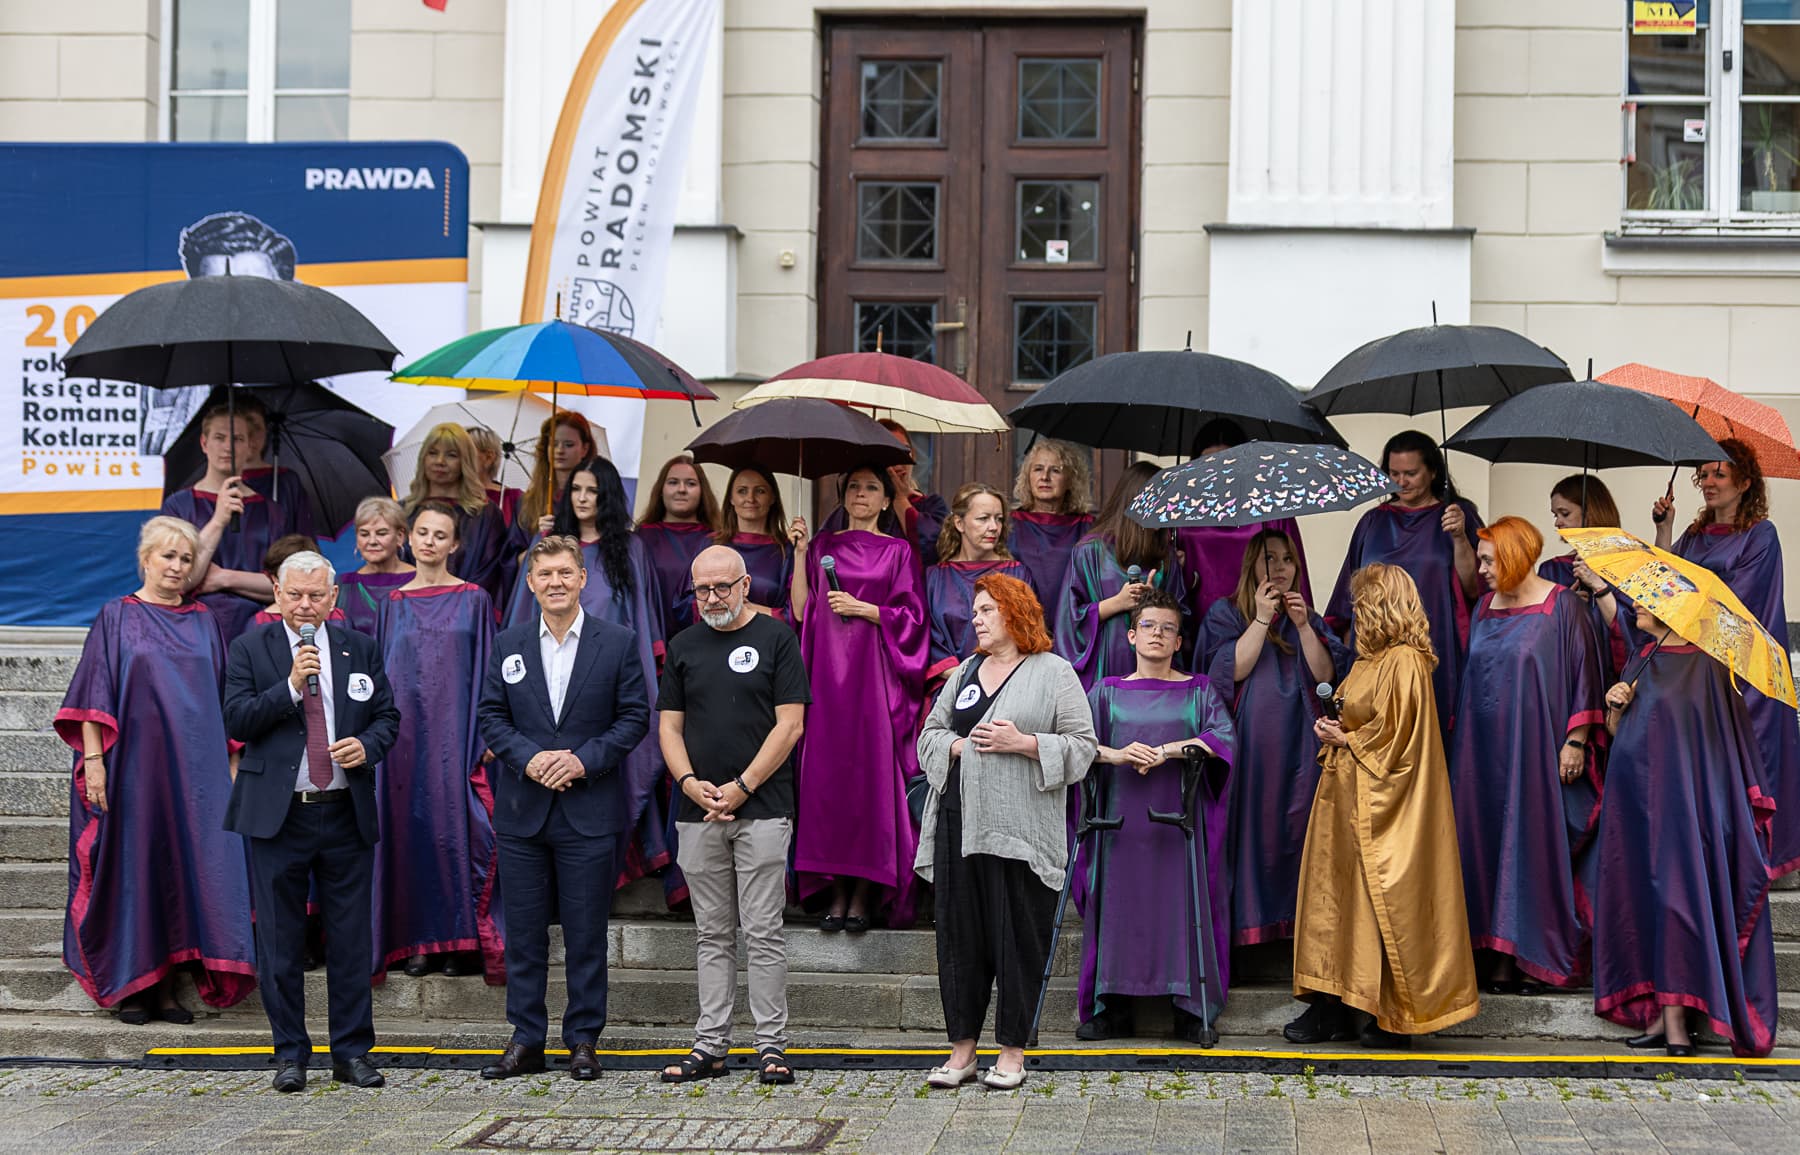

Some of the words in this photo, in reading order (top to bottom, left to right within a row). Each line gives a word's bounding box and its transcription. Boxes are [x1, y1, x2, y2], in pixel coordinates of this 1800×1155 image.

[600, 38, 662, 270] RADOMSKI
[305, 167, 435, 190] PRAWDA
[577, 146, 608, 267] POWIAT
[22, 377, 137, 403] księdza
[23, 401, 137, 422] Romana
[23, 427, 137, 447] Kotlarza
[22, 458, 141, 476] Powiat
